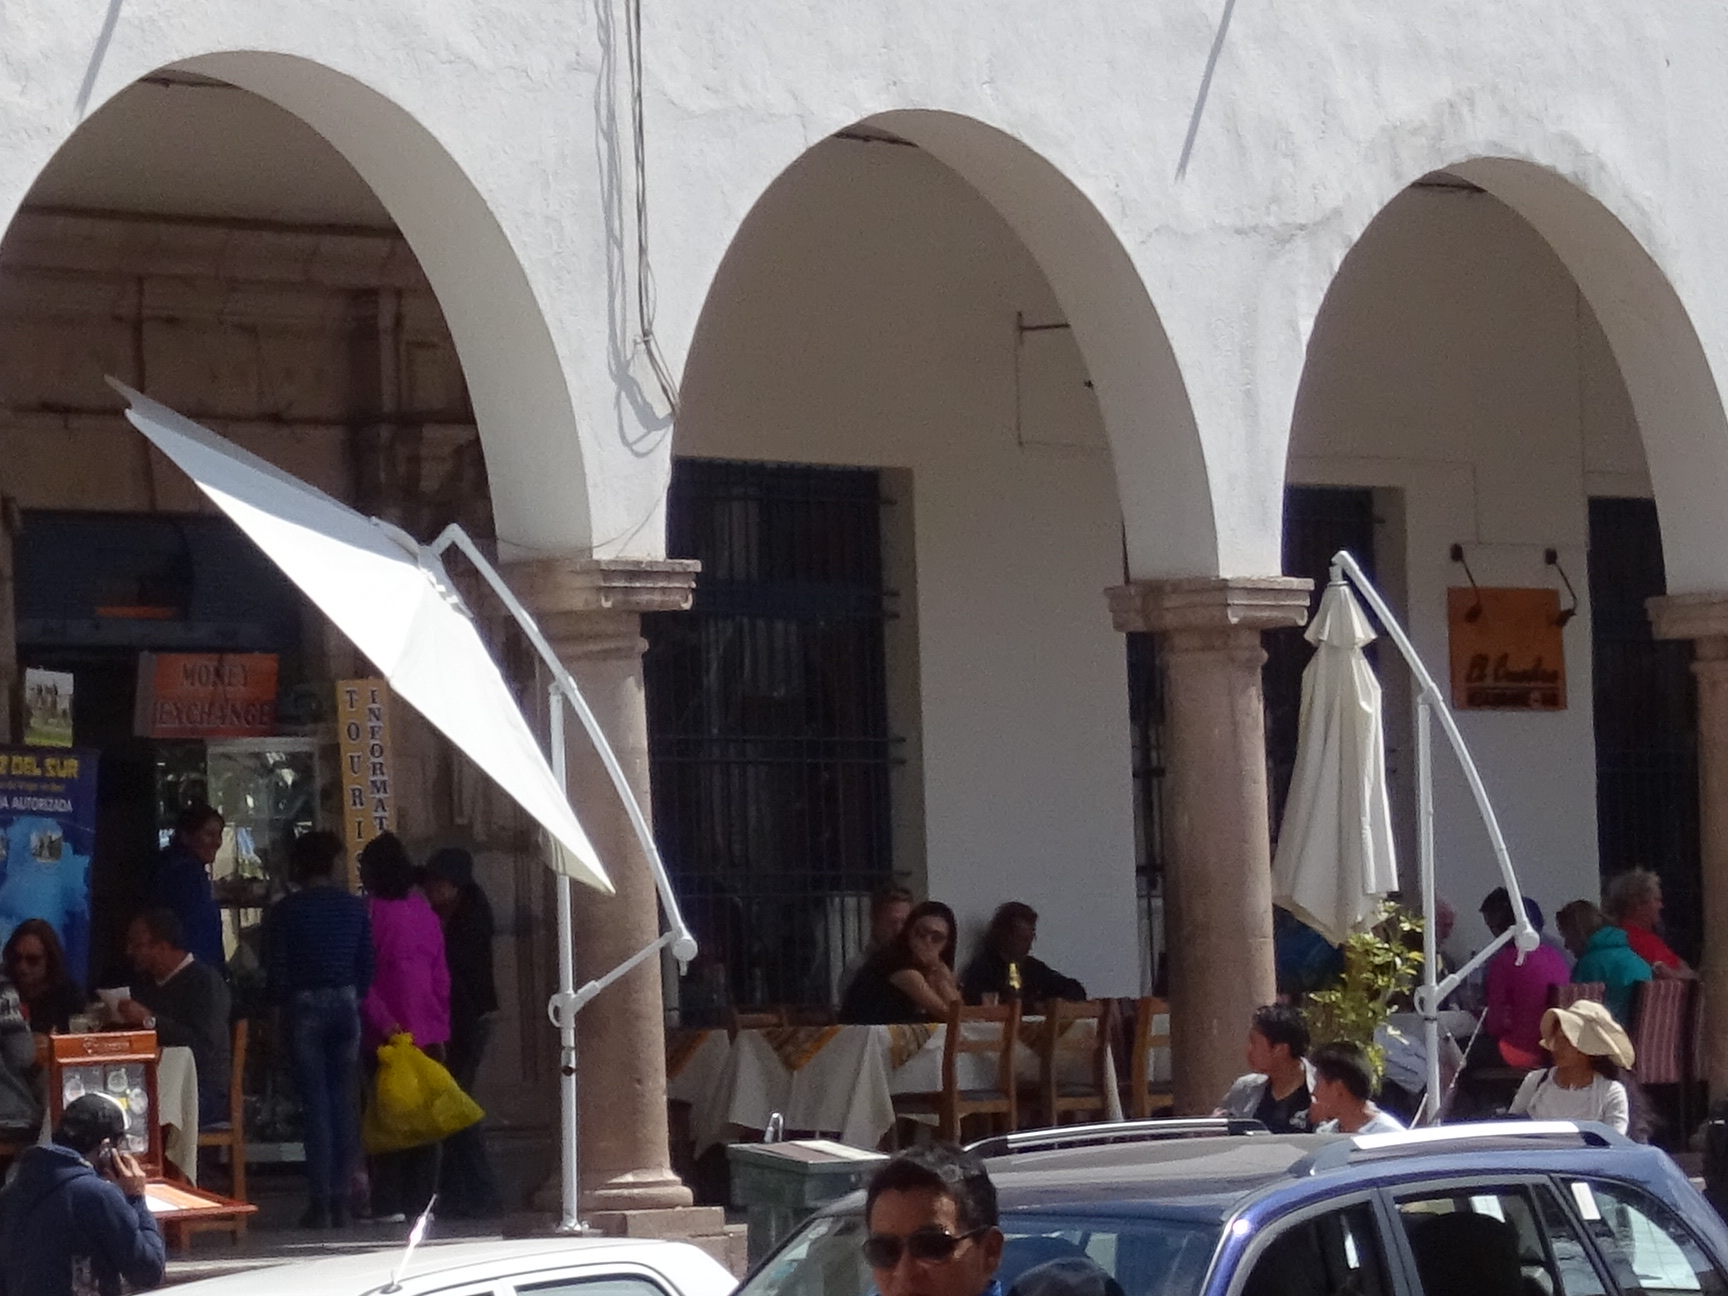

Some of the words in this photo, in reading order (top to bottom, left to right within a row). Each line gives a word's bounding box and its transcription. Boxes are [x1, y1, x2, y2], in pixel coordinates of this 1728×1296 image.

[180, 663, 250, 688] MONEY
[154, 701, 273, 726] EXCHANGE
[11, 755, 42, 776] DEL
[45, 757, 79, 779] SUR
